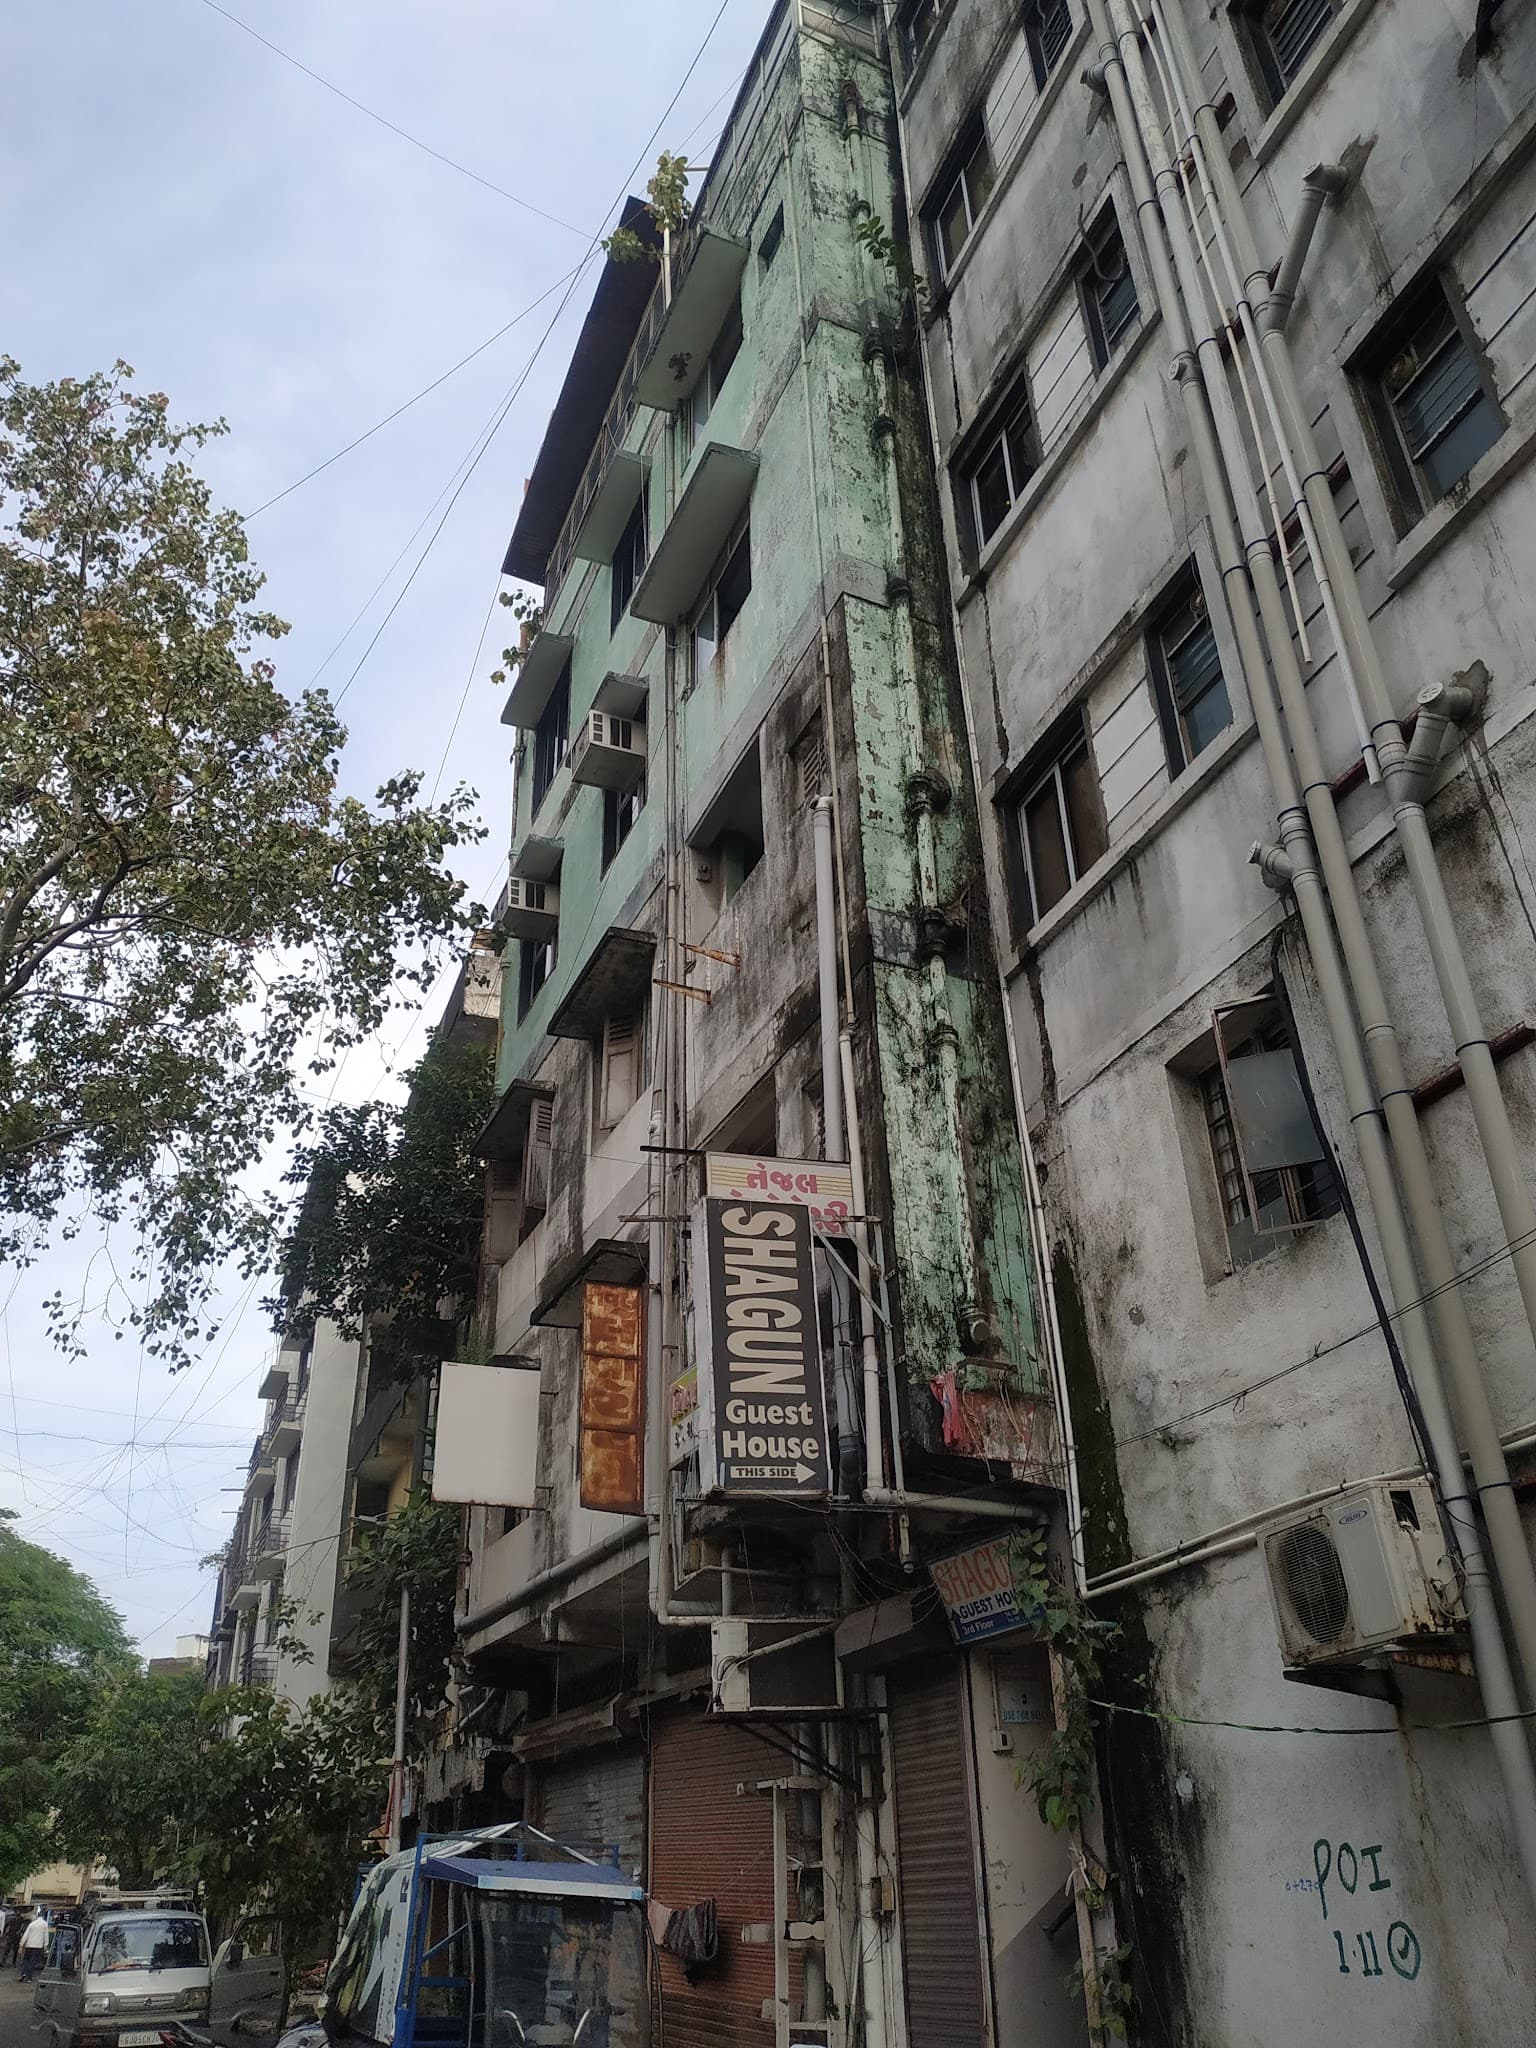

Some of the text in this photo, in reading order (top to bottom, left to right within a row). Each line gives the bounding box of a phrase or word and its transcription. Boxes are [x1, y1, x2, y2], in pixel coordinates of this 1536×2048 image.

[720, 1206, 806, 1394] SHAGUN
[725, 1398, 814, 1426] Guest
[722, 1430, 820, 1460] House
[735, 1467, 797, 1477] THIS SIDE
[934, 1541, 1014, 1605] SHAGU
[959, 1597, 993, 1619] GUEST
[961, 1620, 995, 1636] 3rd Floor
[1313, 1838, 1391, 1920] POI
